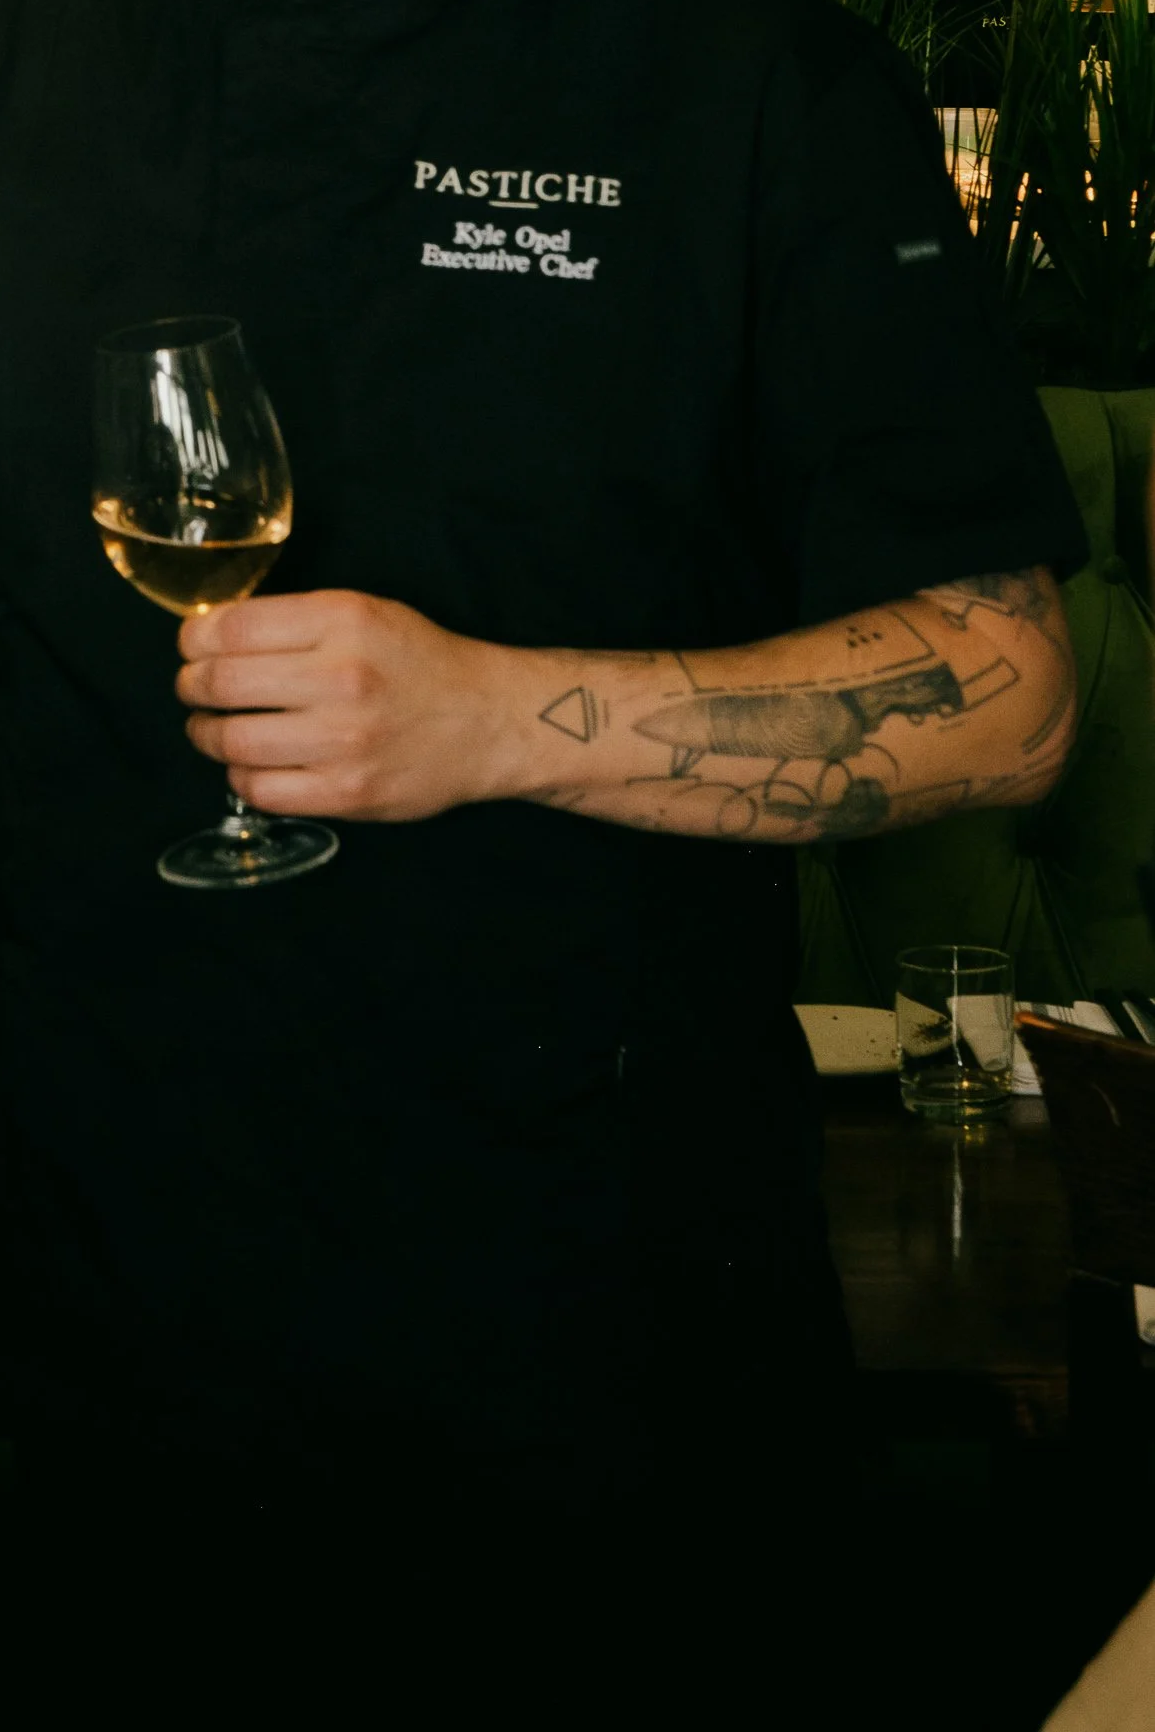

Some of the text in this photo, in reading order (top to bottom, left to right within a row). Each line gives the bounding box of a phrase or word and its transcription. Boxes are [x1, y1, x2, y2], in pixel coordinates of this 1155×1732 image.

[414, 160, 621, 207] PASTICHE
[453, 221, 571, 254] Kyle Opel
[421, 243, 600, 280] Executive Chef
